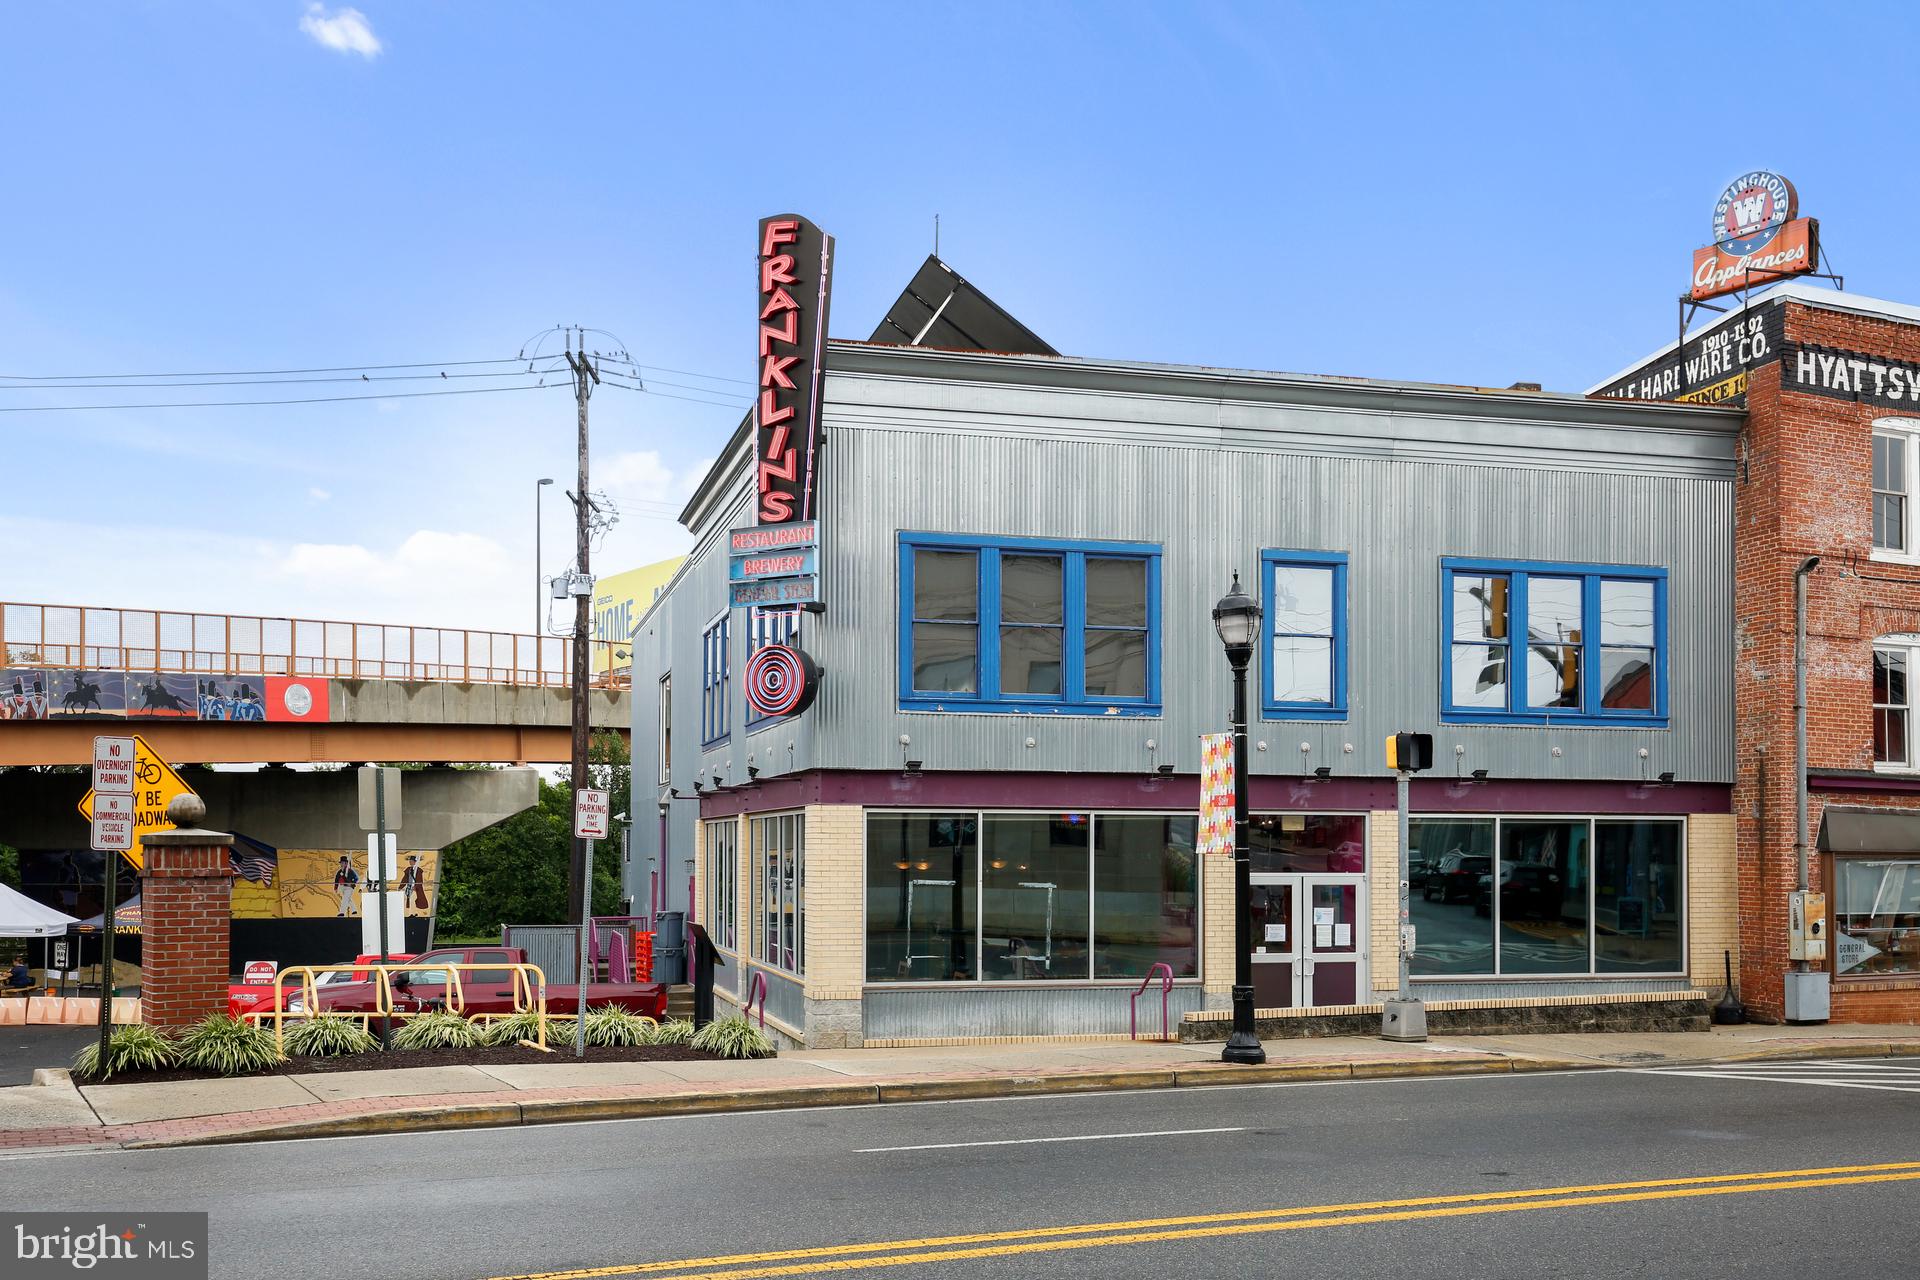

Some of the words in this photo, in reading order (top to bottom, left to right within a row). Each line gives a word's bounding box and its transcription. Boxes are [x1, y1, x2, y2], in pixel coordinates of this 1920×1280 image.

[1715, 173, 1786, 241] WESTINGHOUSE
[1694, 244, 1805, 289] Appliances
[1738, 332, 1771, 364] CO.
[760, 220, 799, 523] FRANKLINS
[732, 526, 814, 548] RESTAURANT
[743, 556, 804, 576] BREWERY
[597, 599, 634, 650] HOME
[109, 744, 120, 756] NO
[96, 760, 132, 771] OVERNIGHT
[100, 773, 128, 784] PARKING
[146, 791, 162, 806] BE
[588, 793, 599, 803] NO
[109, 800, 118, 809] NO
[579, 804, 606, 814] PARKING
[95, 812, 131, 821] COMMERCIAL
[101, 823, 124, 832] VEHICLE
[100, 835, 124, 843] PARKING
[114, 925, 142, 934] RANK
[1839, 943, 1865, 953] GENERAL
[1841, 955, 1859, 963] STORE
